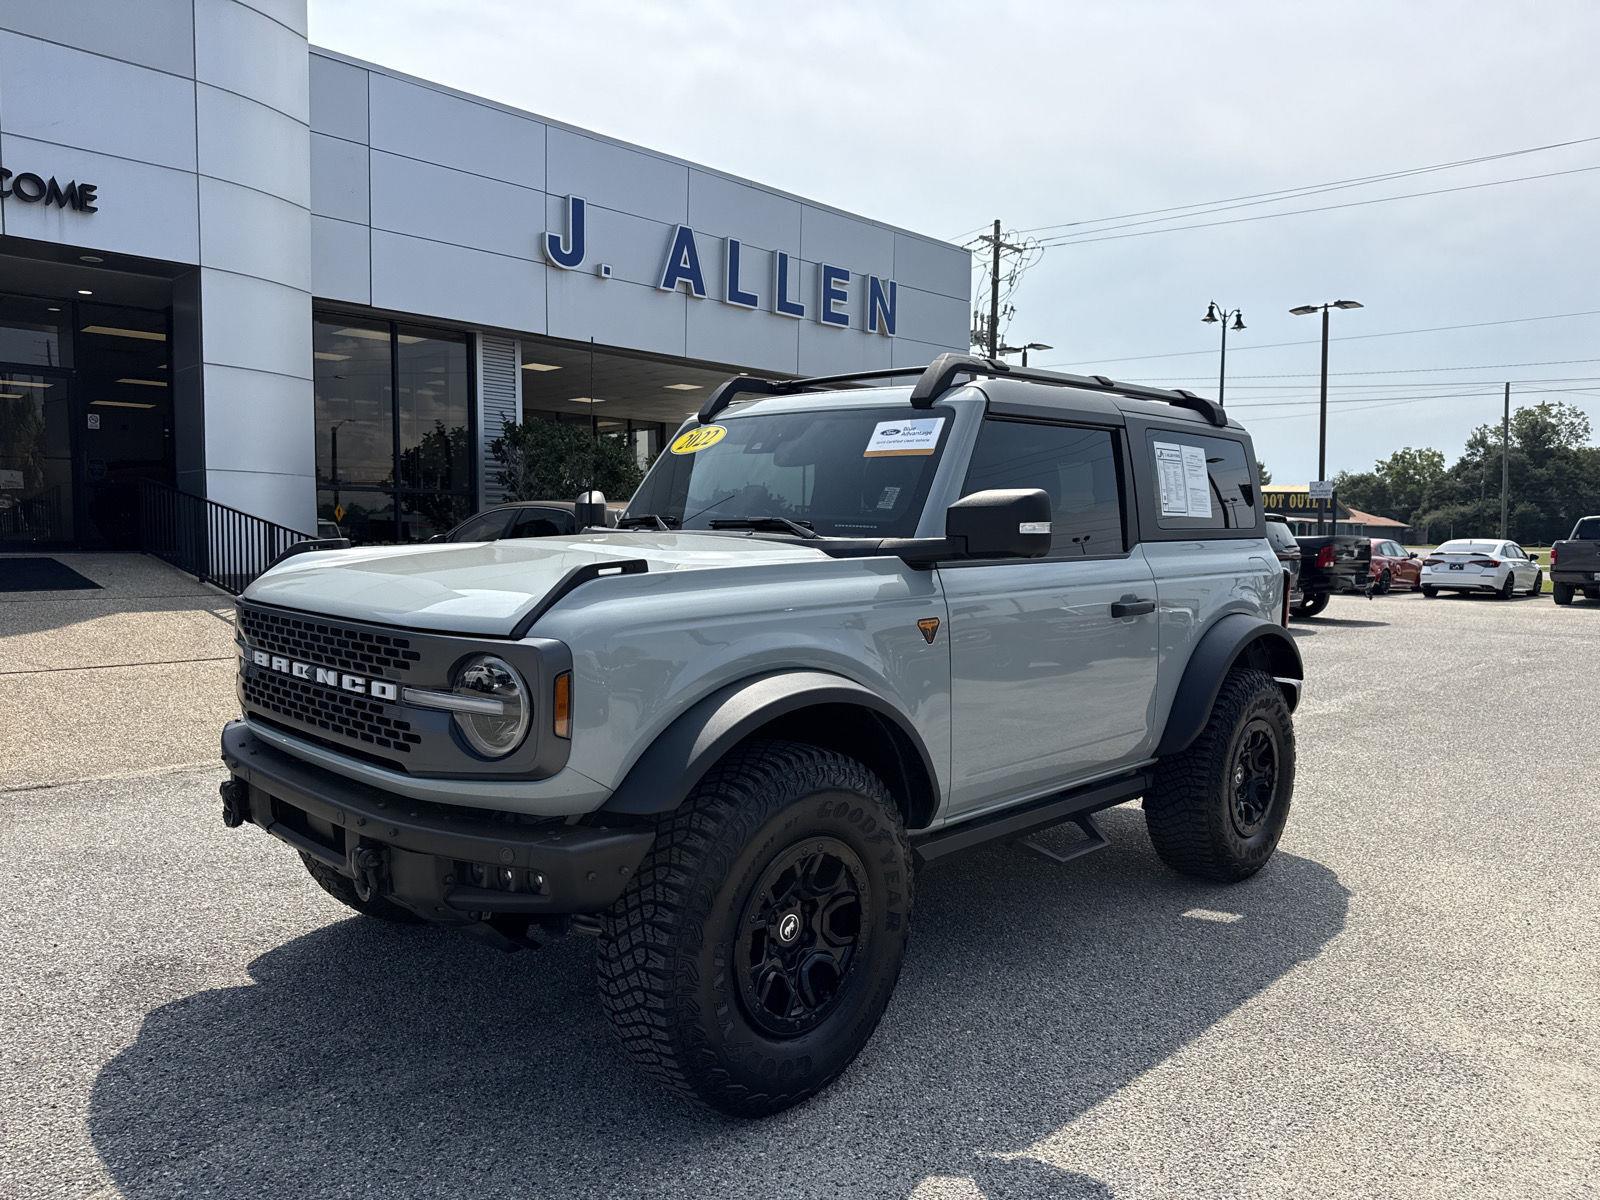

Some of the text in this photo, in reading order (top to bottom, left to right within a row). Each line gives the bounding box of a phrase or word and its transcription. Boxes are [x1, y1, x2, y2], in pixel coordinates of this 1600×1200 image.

[542, 194, 898, 337] J. ALLEN
[676, 429, 721, 450] 2022
[1289, 494, 1331, 508] OUTLT
[254, 650, 396, 700] BRONCO
[817, 800, 902, 931] GOODYEAR
